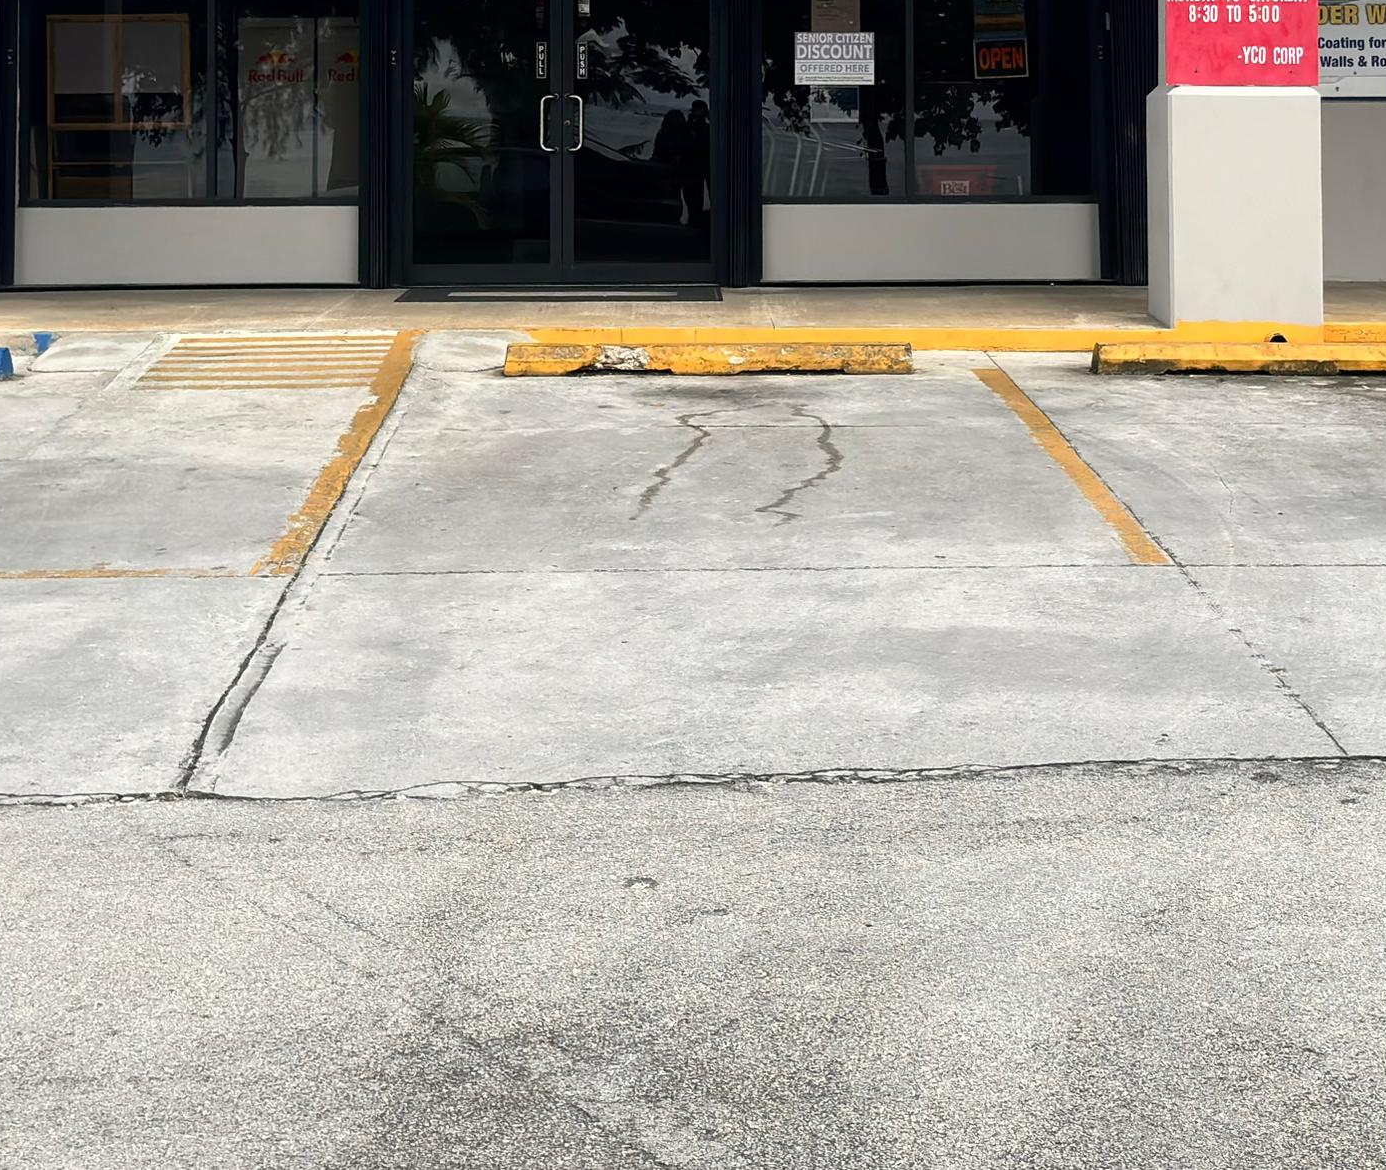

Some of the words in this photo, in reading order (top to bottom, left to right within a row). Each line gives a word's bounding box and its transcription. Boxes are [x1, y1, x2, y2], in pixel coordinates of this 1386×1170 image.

[1188, 4, 1219, 23] 8:30
[1226, 4, 1242, 23] TO
[1248, 4, 1281, 23] 5:00
[796, 33, 834, 44] SENIOR
[835, 33, 873, 44] CITIZEN
[1318, 36, 1365, 51] Coating
[1369, 36, 1386, 49] for
[796, 44, 873, 59] DISCOUNT
[978, 46, 1025, 71] OPEN
[1273, 46, 1305, 65] CORP
[799, 64, 844, 73] OFFERED
[845, 64, 870, 73] HERE
[1319, 55, 1355, 68] Walls
[1357, 55, 1368, 67] &
